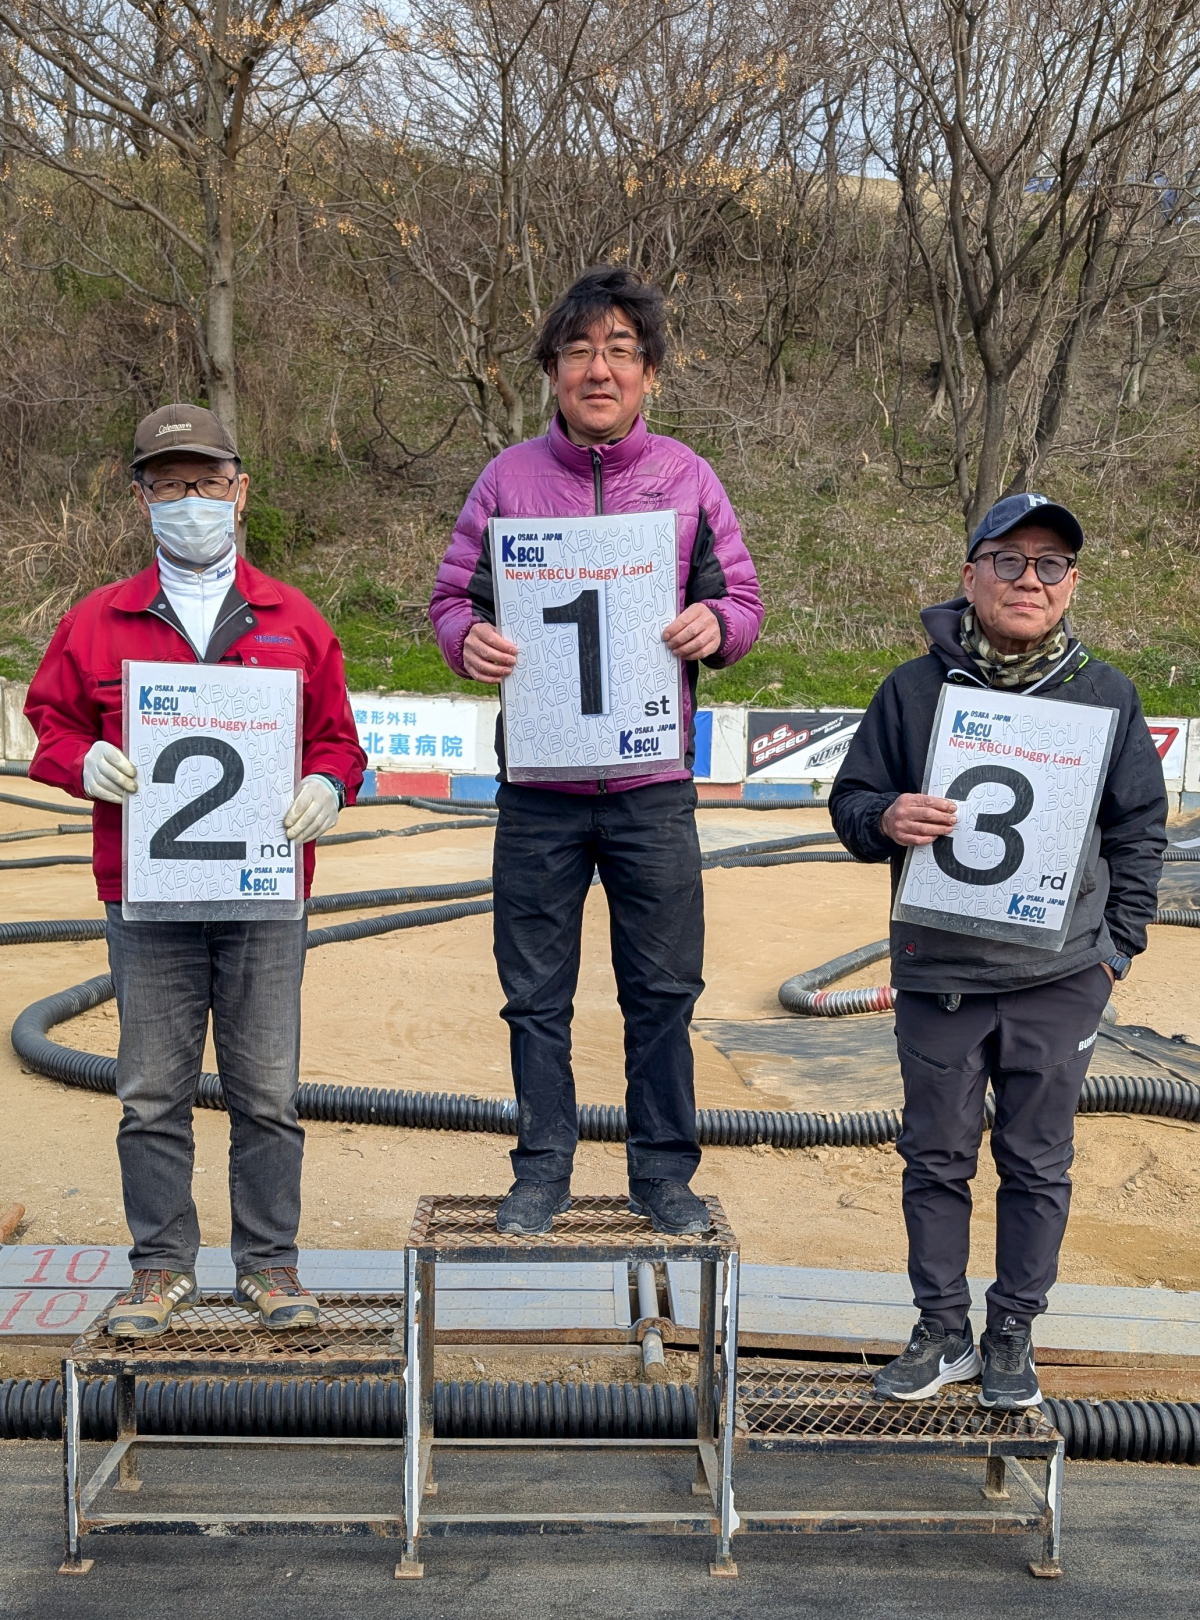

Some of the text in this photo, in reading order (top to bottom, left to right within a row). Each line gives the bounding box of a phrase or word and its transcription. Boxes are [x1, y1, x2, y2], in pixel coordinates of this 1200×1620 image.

[501, 535, 544, 563] KBCU
[517, 533, 562, 541] OSAKA JAPAN
[505, 561, 653, 581] New KBCU Buggy Land
[542, 589, 602, 715] 1
[139, 686, 179, 711] KBCU
[644, 695, 670, 717] st
[141, 715, 278, 731] New KBCU Buggy Land
[354, 709, 417, 726] 整形外科
[952, 710, 992, 738] KBCU
[971, 710, 1011, 722] OSAKA JAPAN
[634, 724, 676, 735] OSAKA JAPAN
[362, 732, 463, 758] 北裏病院
[619, 730, 659, 756] KBCU
[754, 734, 808, 764] SPEED
[948, 737, 976, 750] New
[978, 741, 1012, 755] KBCU
[1014, 747, 1050, 763] Buggy
[1053, 753, 1081, 766] Land
[149, 735, 247, 861] 2
[932, 764, 1034, 886] 3
[260, 839, 292, 858] nd
[240, 869, 277, 892] KBCU
[1039, 872, 1067, 891] rd
[1007, 894, 1046, 919] KBCU
[1026, 895, 1066, 906] OSAKA JAPAN
[23, 1248, 111, 1284] 10
[0, 1290, 89, 1330] 10
